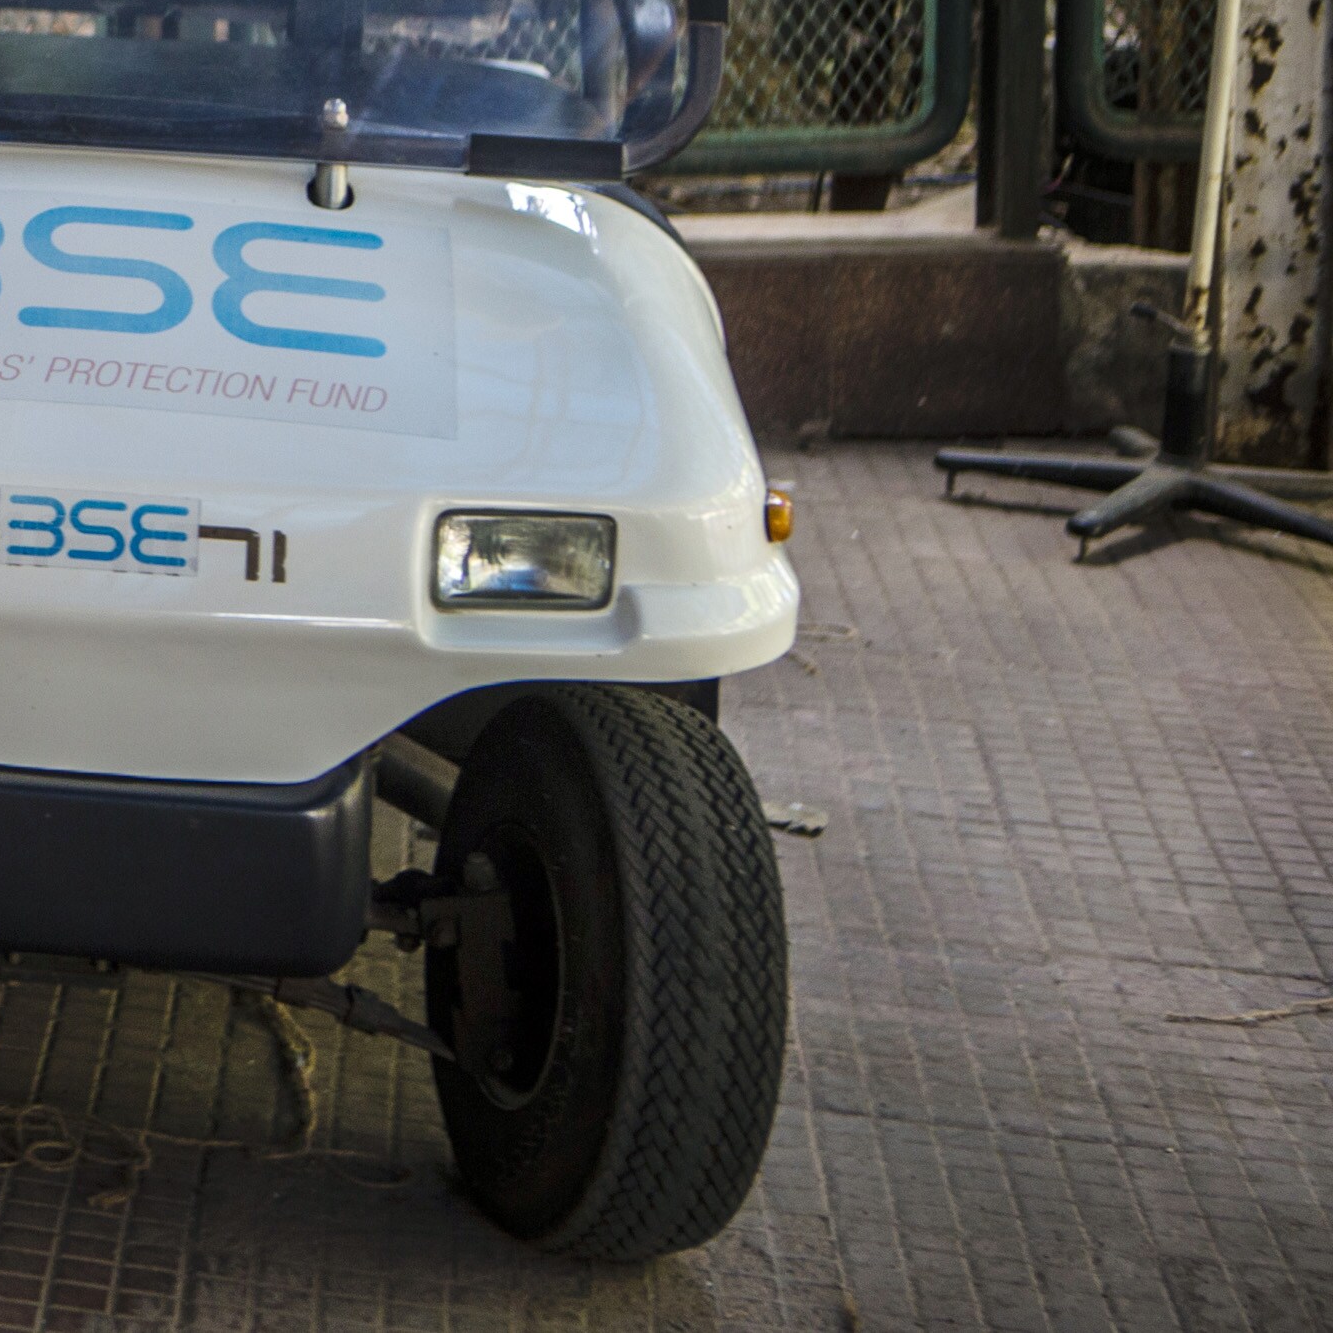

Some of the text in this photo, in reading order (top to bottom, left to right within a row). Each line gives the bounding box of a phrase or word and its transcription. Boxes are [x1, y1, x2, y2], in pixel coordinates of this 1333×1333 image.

[44, 356, 277, 402] PROTECTION
[287, 377, 389, 414] FUND
[6, 494, 190, 567] BSE
